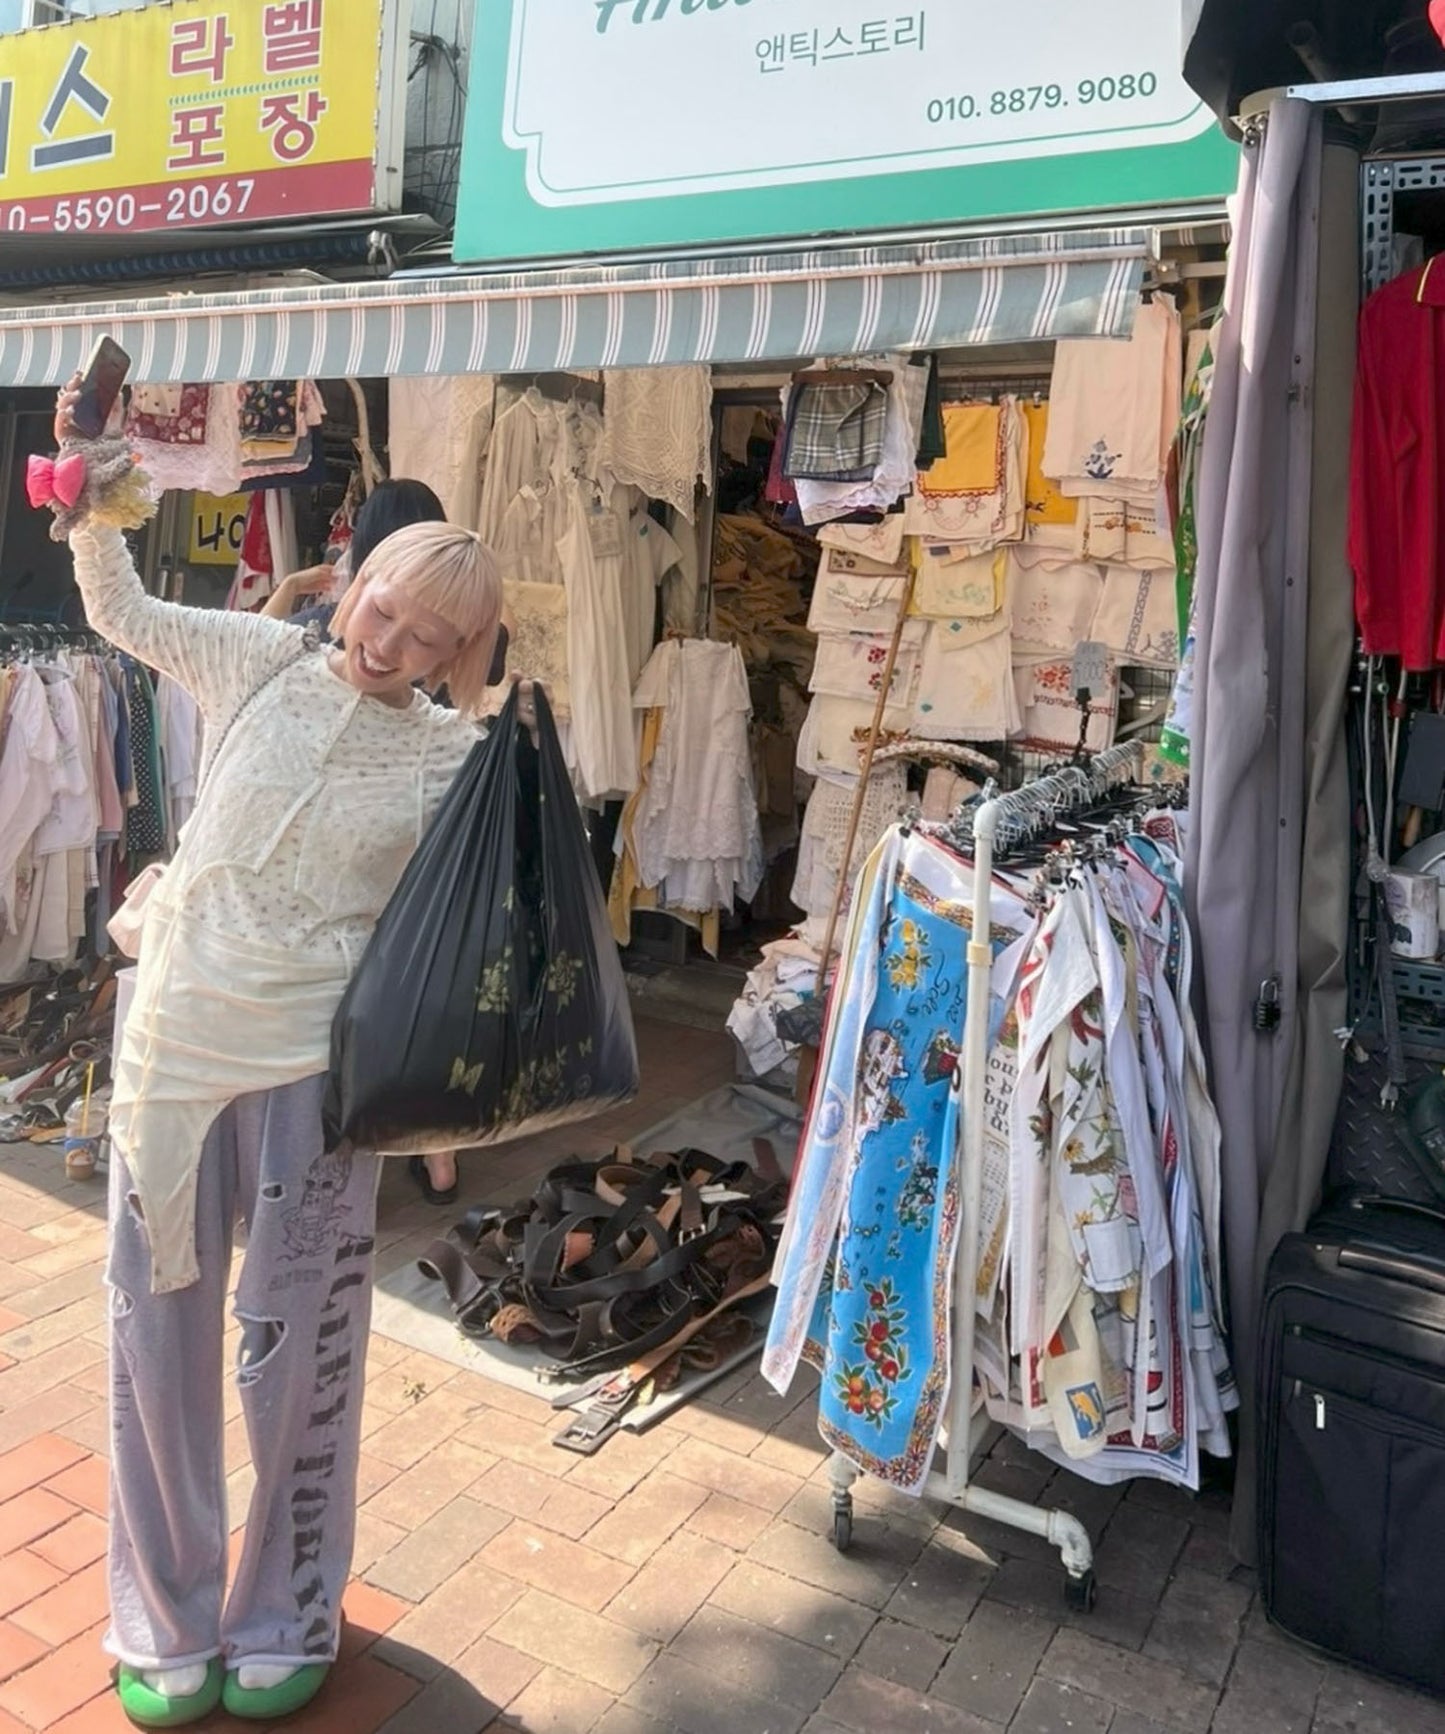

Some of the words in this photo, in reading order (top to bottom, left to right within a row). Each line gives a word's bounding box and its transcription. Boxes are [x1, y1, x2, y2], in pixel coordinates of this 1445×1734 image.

[756, 11, 925, 74] 앤틱스토리
[927, 98, 981, 123] 010.
[989, 83, 1069, 115] 8879.
[1077, 71, 1158, 105] 9080
[0, 179, 255, 231] 0-5590-2067
